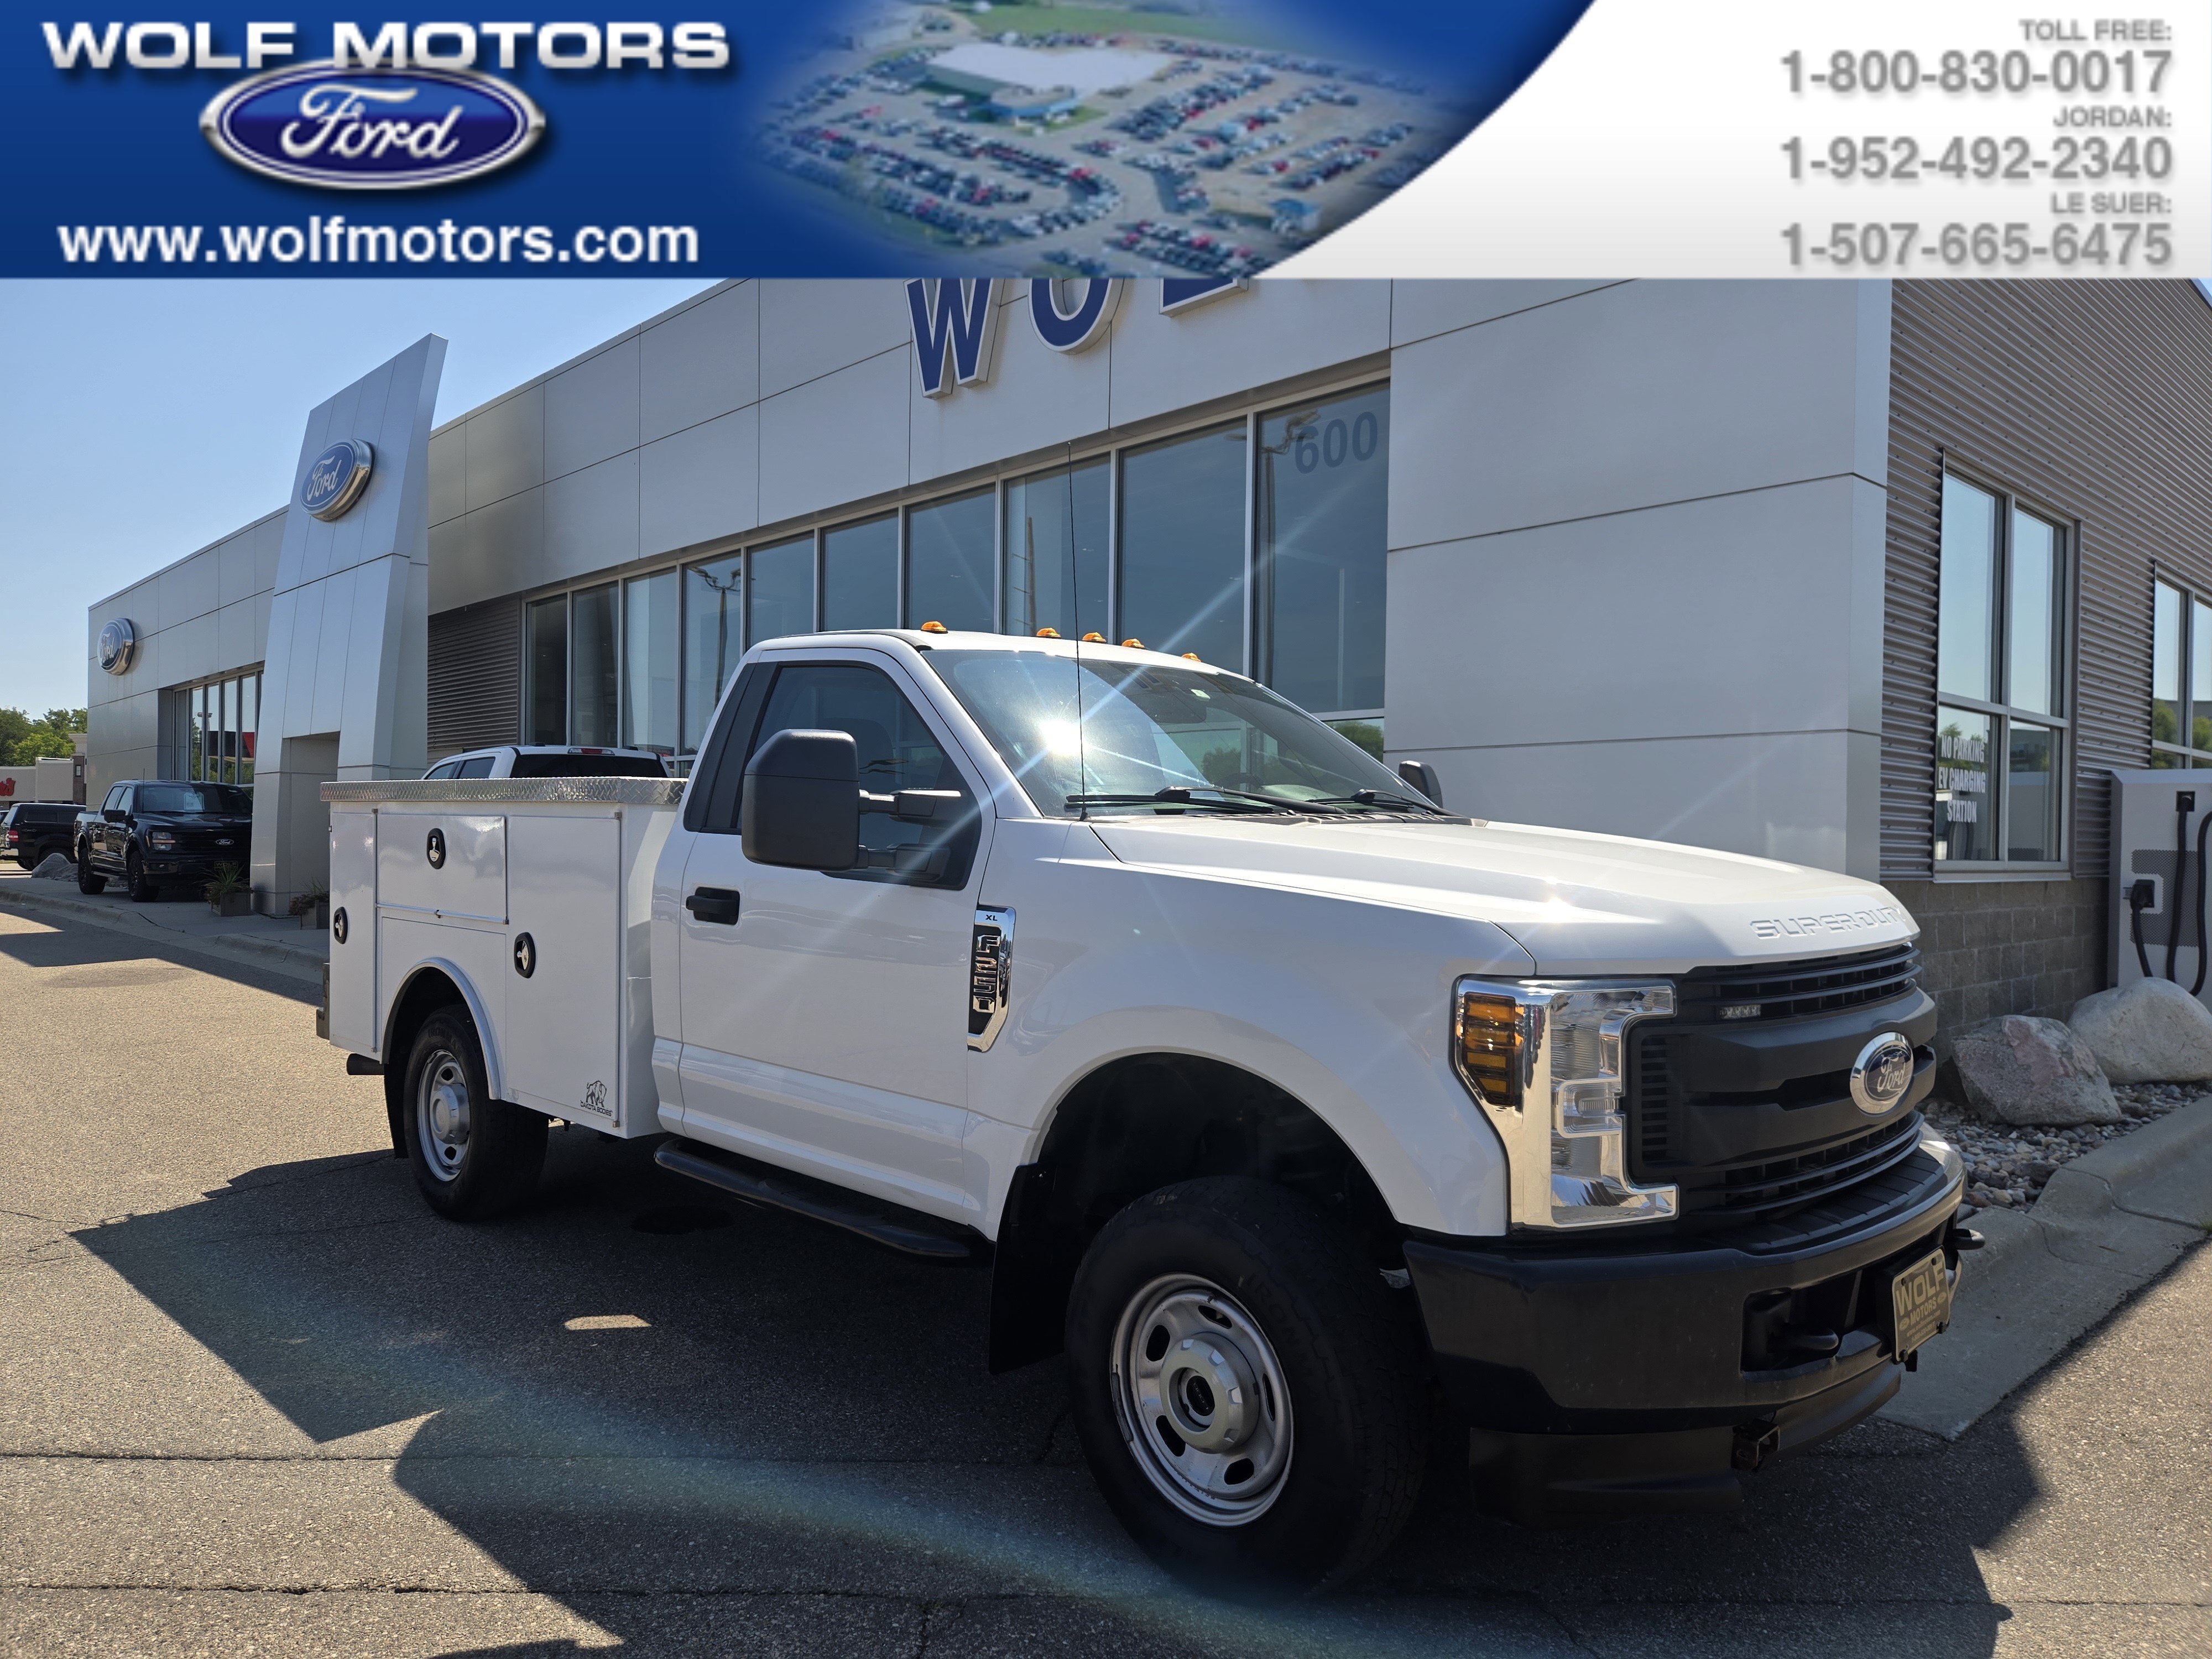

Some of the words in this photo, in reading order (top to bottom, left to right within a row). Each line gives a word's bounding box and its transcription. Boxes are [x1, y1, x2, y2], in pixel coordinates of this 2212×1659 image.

[1294, 411, 1378, 475] 600
[307, 455, 342, 502] Ford
[1941, 735, 1952, 759] NO
[1953, 737, 1985, 763] PARKING
[1938, 766, 1948, 789] EV
[1949, 768, 1986, 794] CHARGING
[1947, 800, 1978, 823] STATION
[1877, 1056, 1906, 1093] Ford
[580, 1101, 597, 1112] DAKOTA
[597, 1106, 613, 1117] BODIES
[1895, 1261, 1944, 1317] WOLF
[1910, 1296, 1937, 1327] MOTORS
